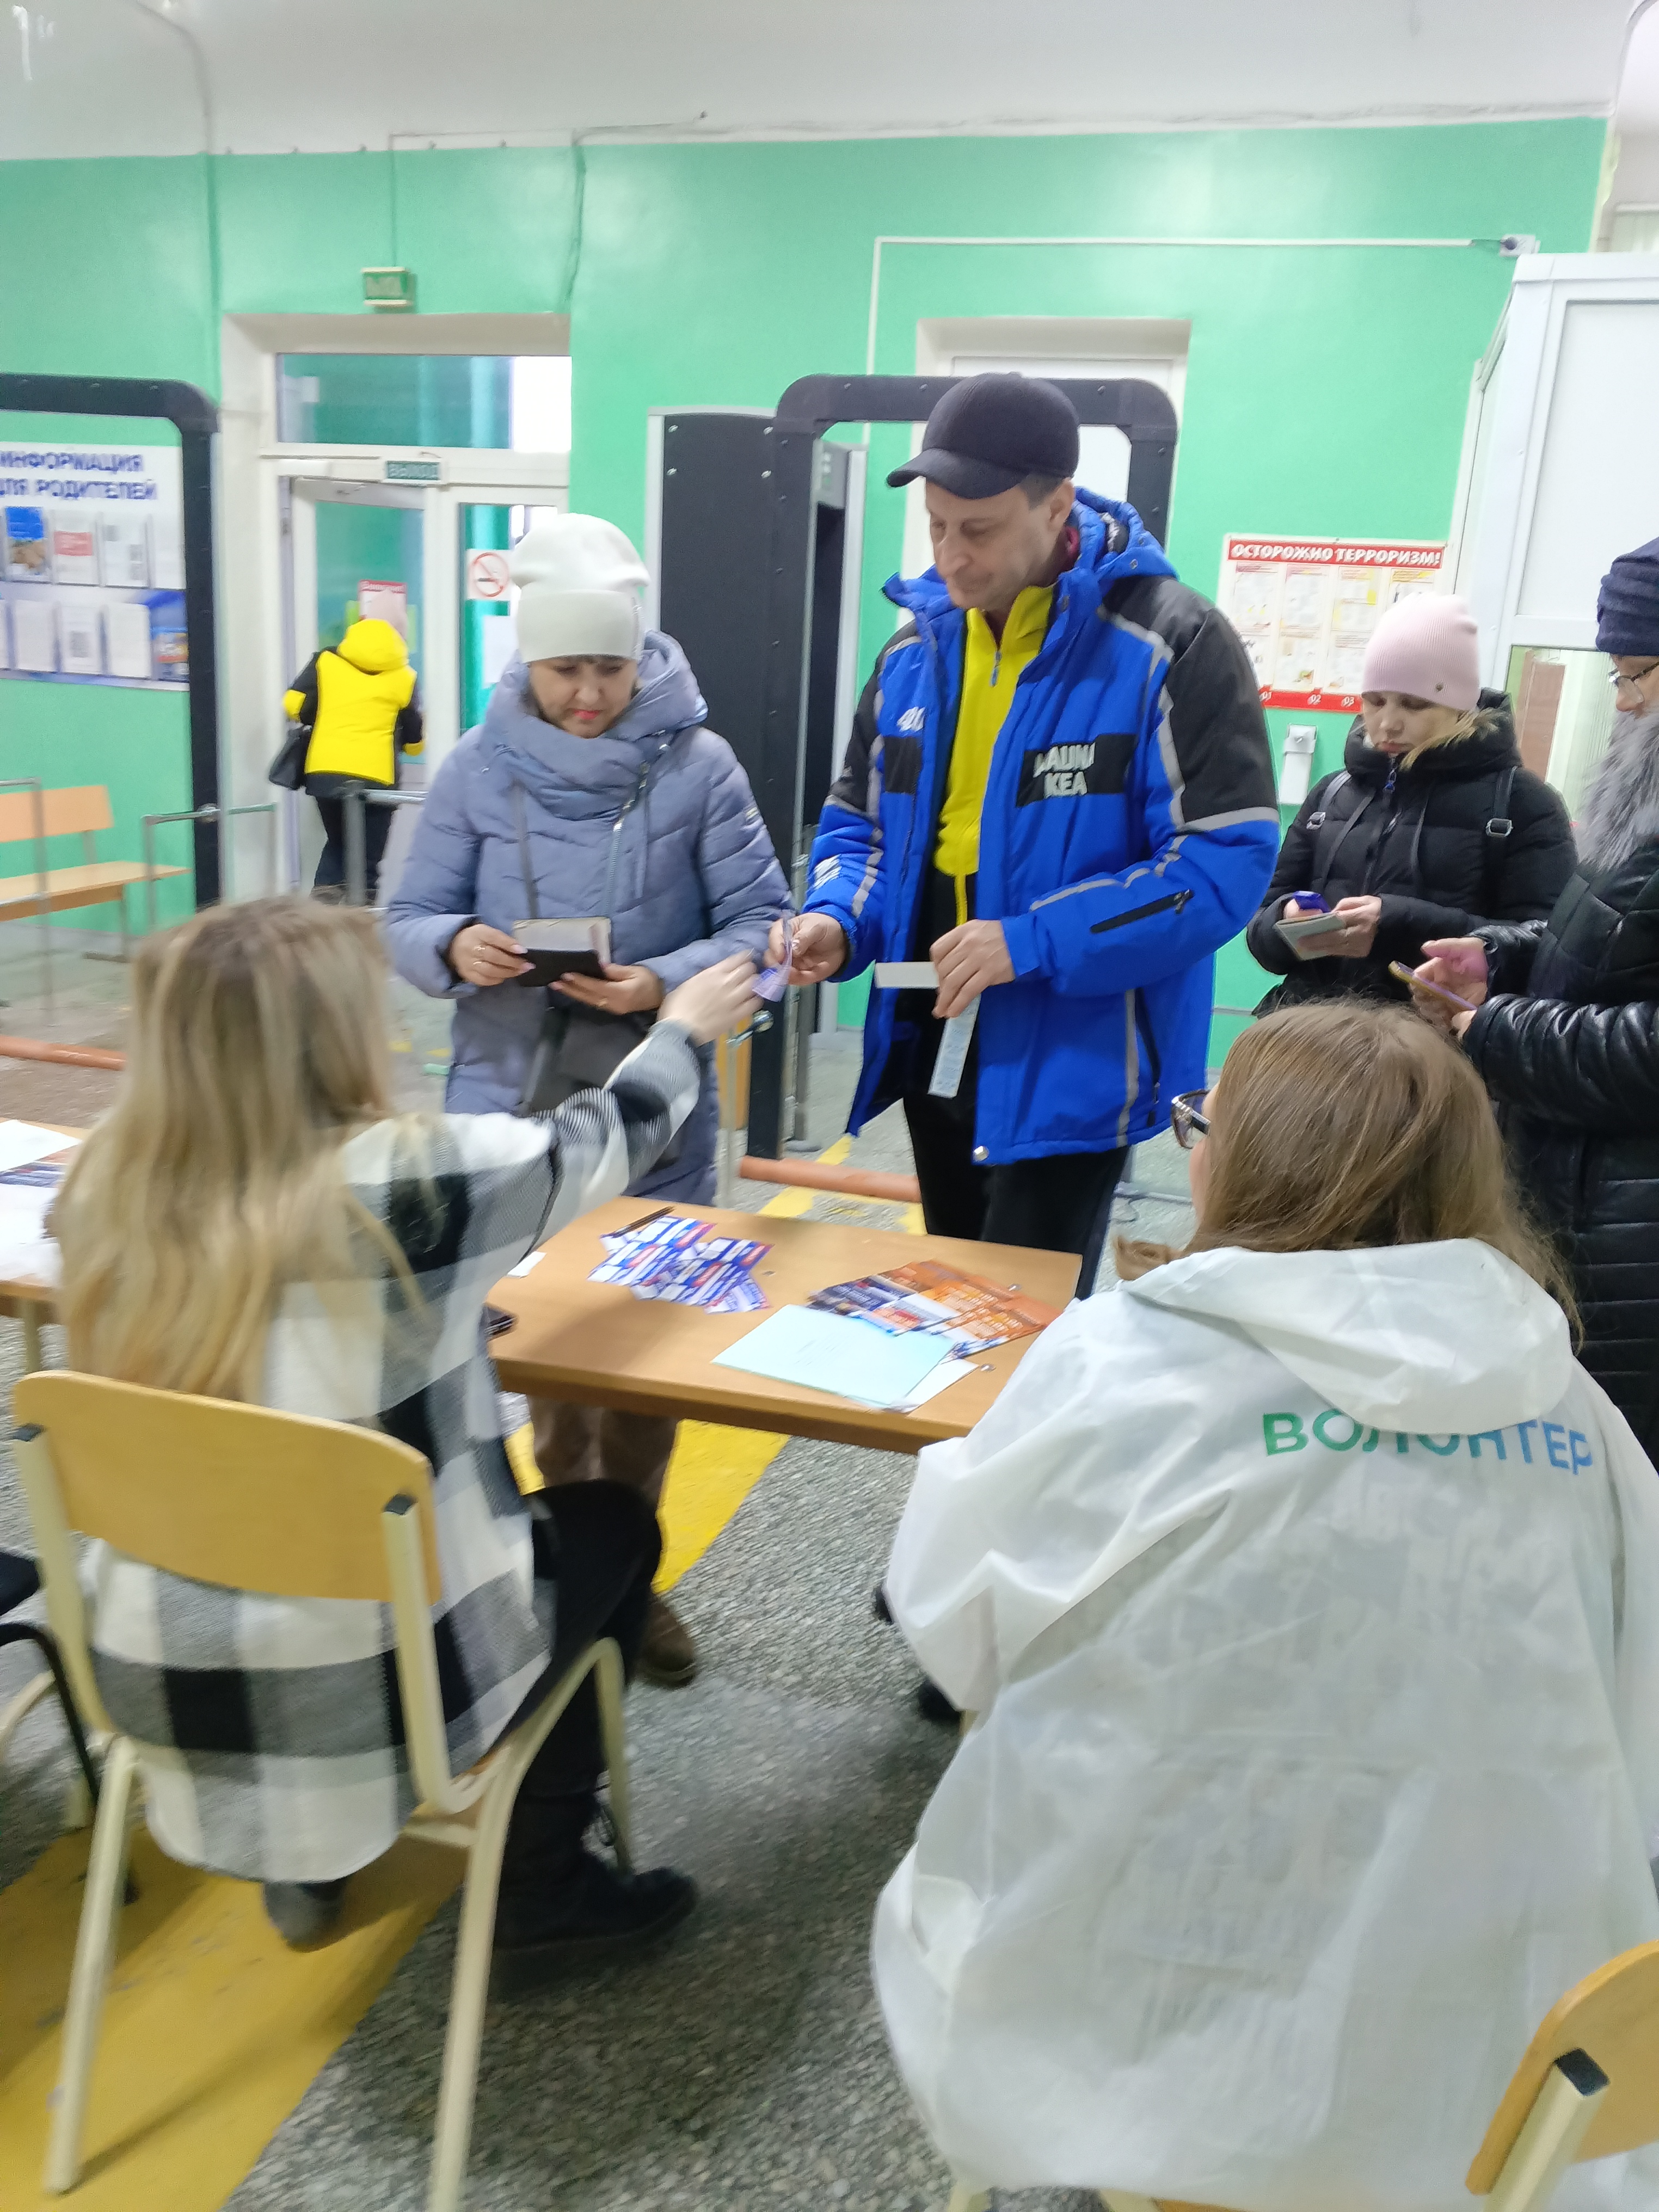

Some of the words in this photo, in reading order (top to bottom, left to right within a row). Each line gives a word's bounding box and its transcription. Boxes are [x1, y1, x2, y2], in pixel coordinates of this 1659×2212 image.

[1232, 544, 1334, 561] ОСТОРОЖНО
[1335, 548, 1441, 567] ТЕРРОРИЗМ!
[1308, 694, 1322, 705] 02
[1043, 771, 1088, 798] KEA
